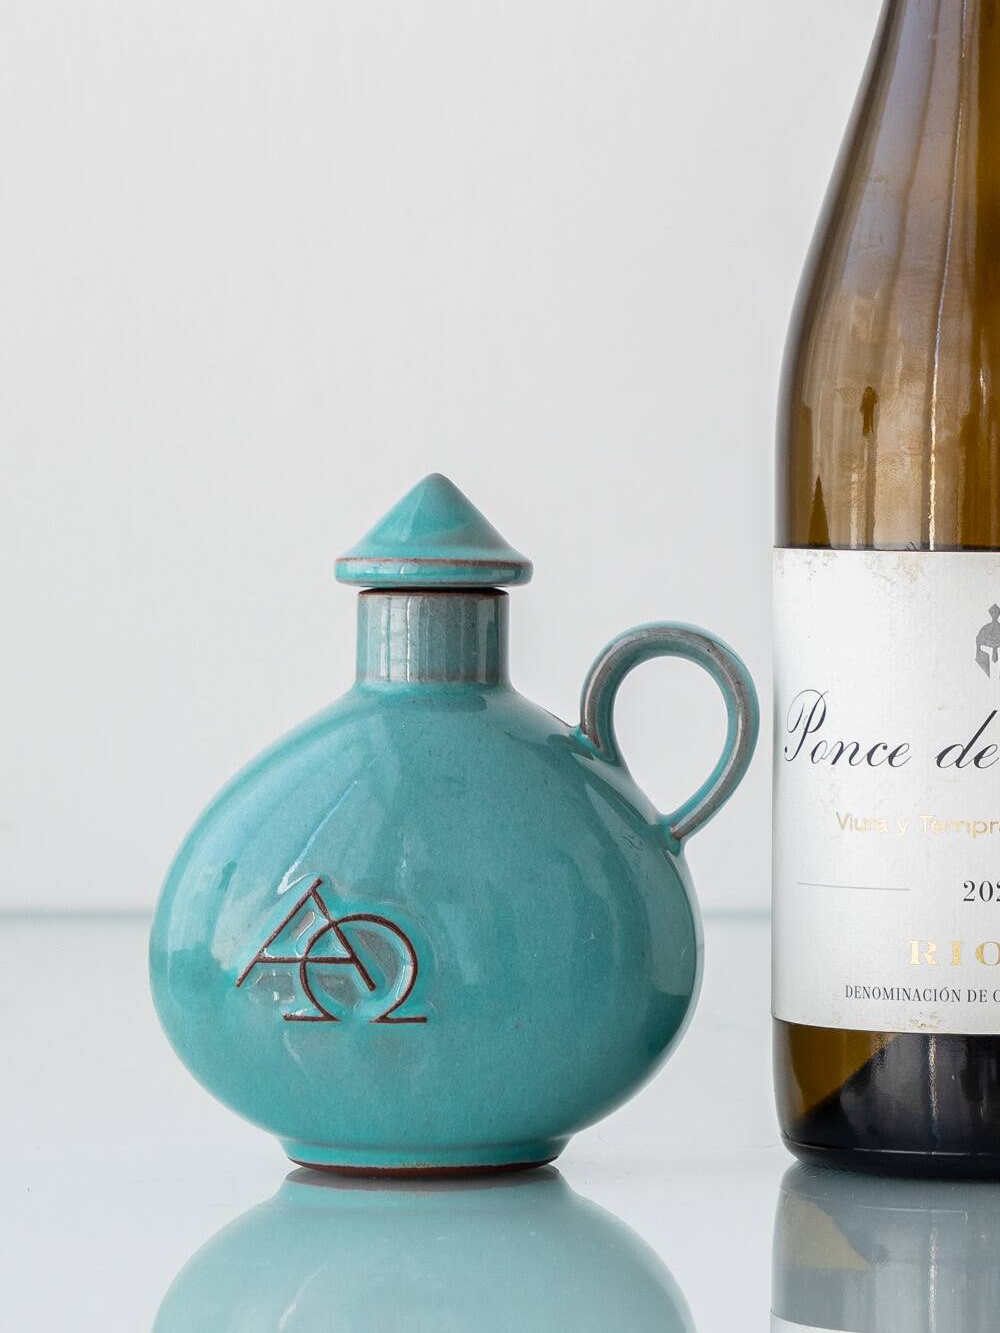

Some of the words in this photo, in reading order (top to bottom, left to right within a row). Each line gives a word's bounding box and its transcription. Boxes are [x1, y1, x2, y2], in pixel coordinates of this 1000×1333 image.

[784, 689, 912, 768] Ponce
[935, 709, 999, 769] de
[836, 812, 889, 834] Viura
[896, 817, 909, 836] y
[844, 984, 962, 1004] DENOMINACIÓN
[966, 988, 988, 1004] DE
